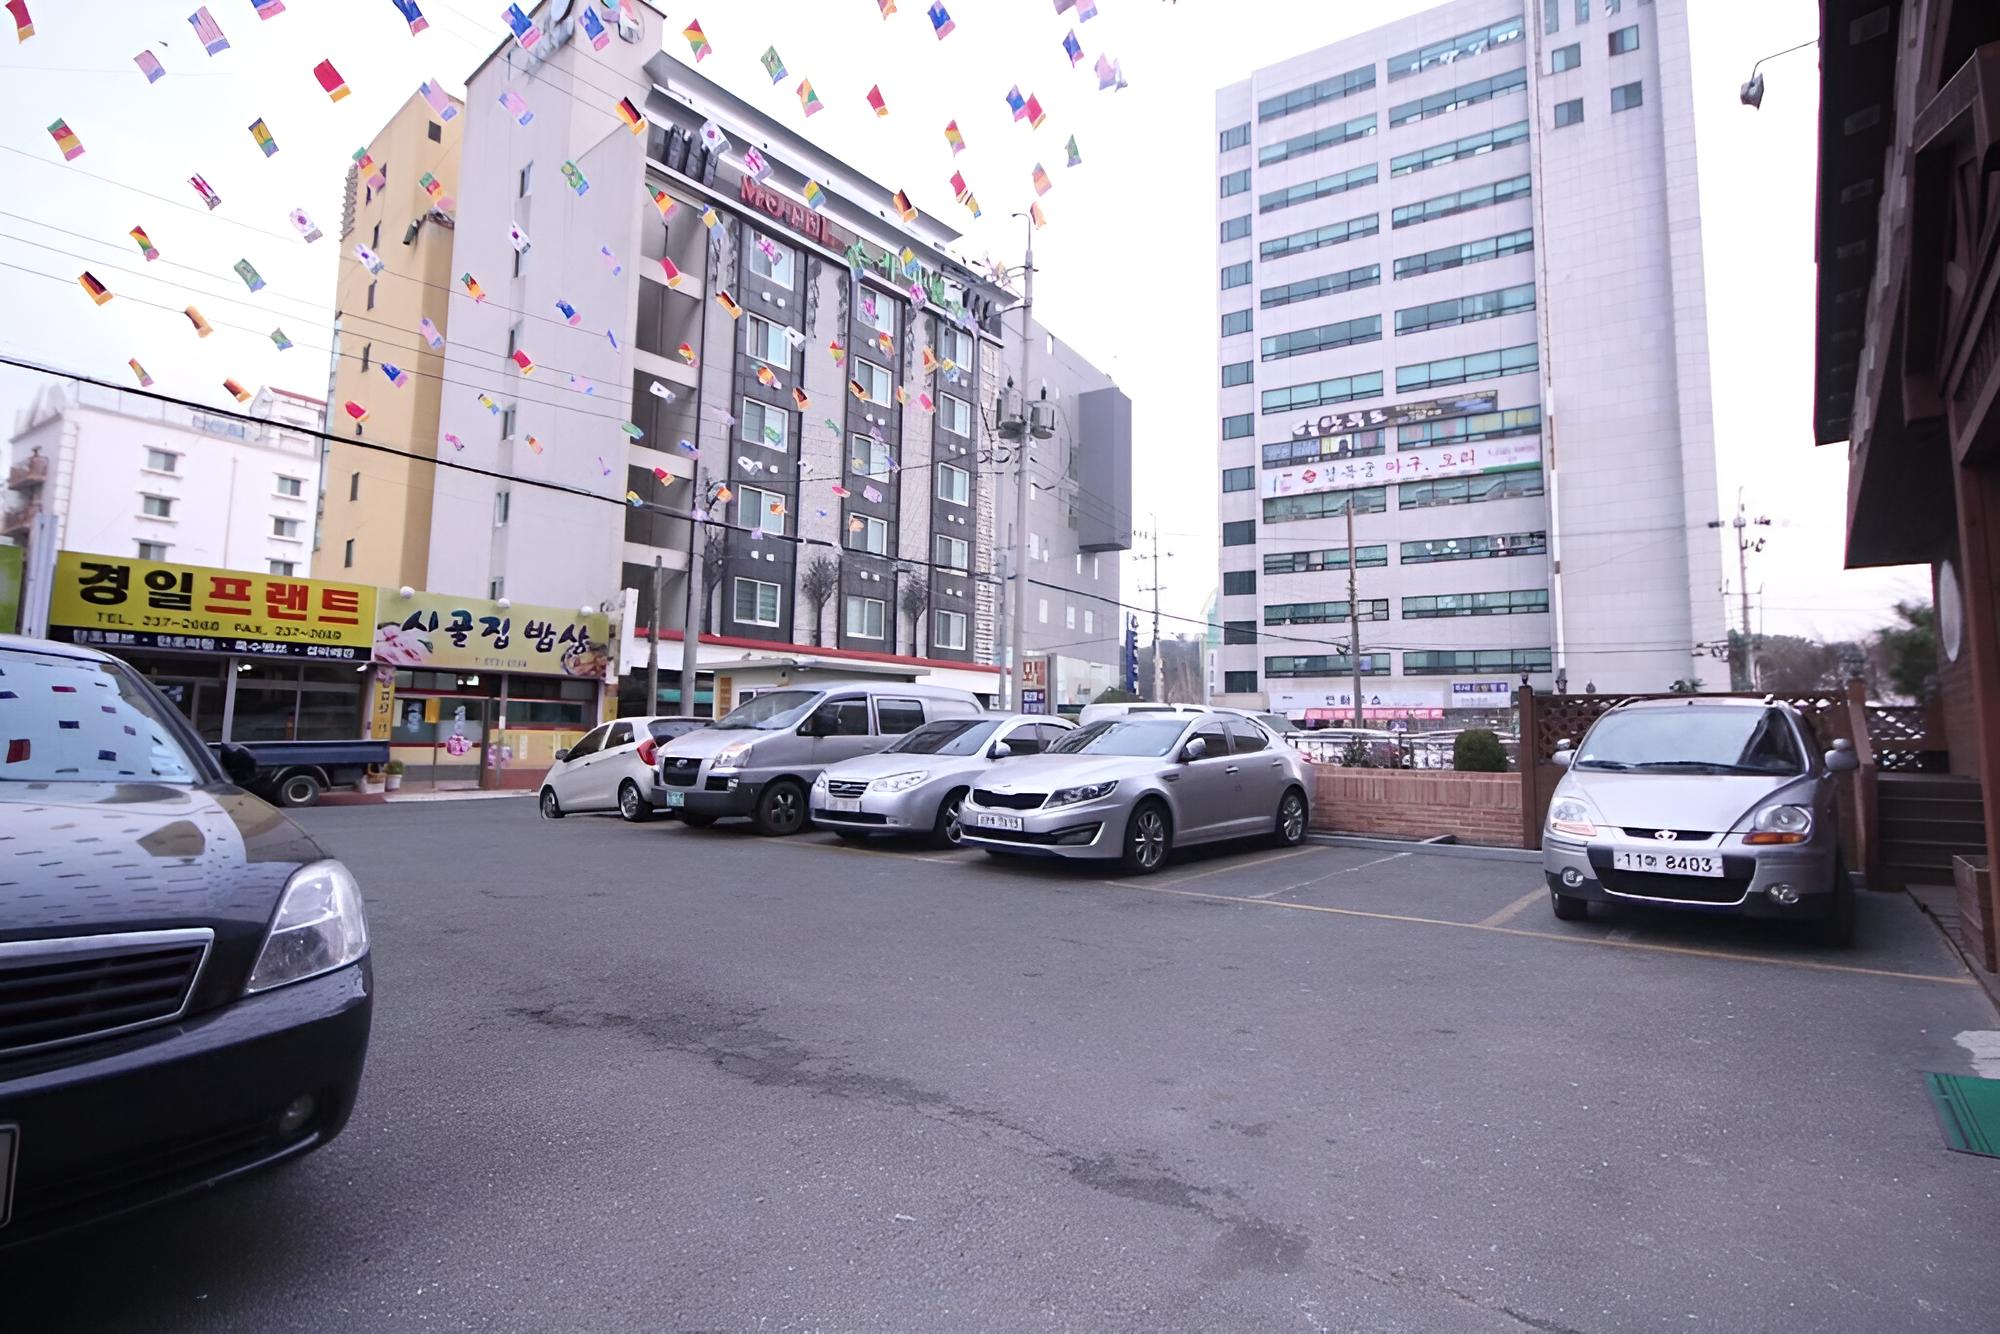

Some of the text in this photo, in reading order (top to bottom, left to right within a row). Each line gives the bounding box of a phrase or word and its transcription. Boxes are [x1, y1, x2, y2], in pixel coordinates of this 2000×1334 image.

[78, 562, 359, 625] 경일프랜트
[401, 609, 591, 656] 시골집 밥상
[1665, 855, 1713, 873] 8403
